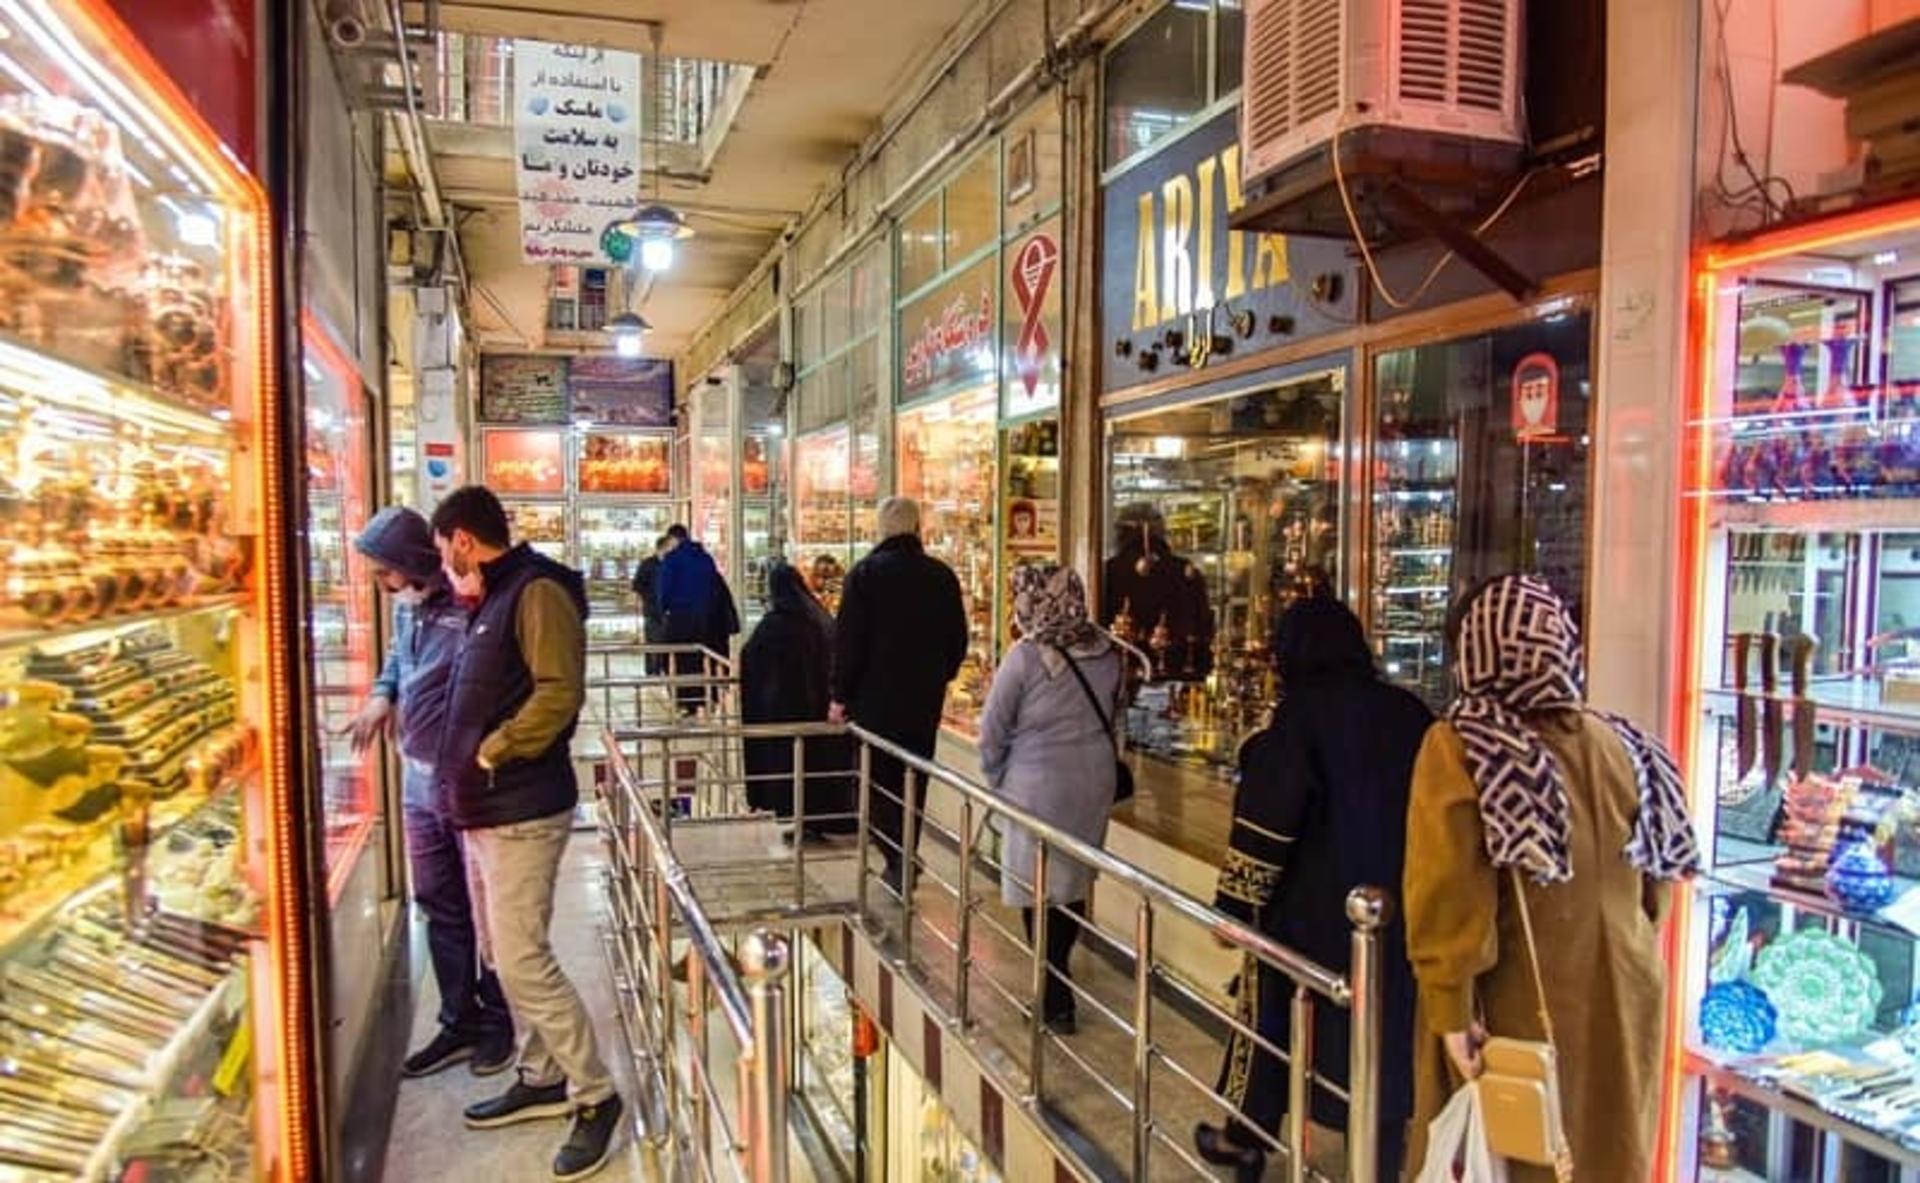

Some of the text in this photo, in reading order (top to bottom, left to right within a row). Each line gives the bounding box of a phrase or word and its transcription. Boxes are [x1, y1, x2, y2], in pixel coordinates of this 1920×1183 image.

[554, 99, 603, 118] ماسک
[543, 127, 618, 154] به سلامت
[559, 163, 568, 180] و
[572, 158, 634, 183] خودتان
